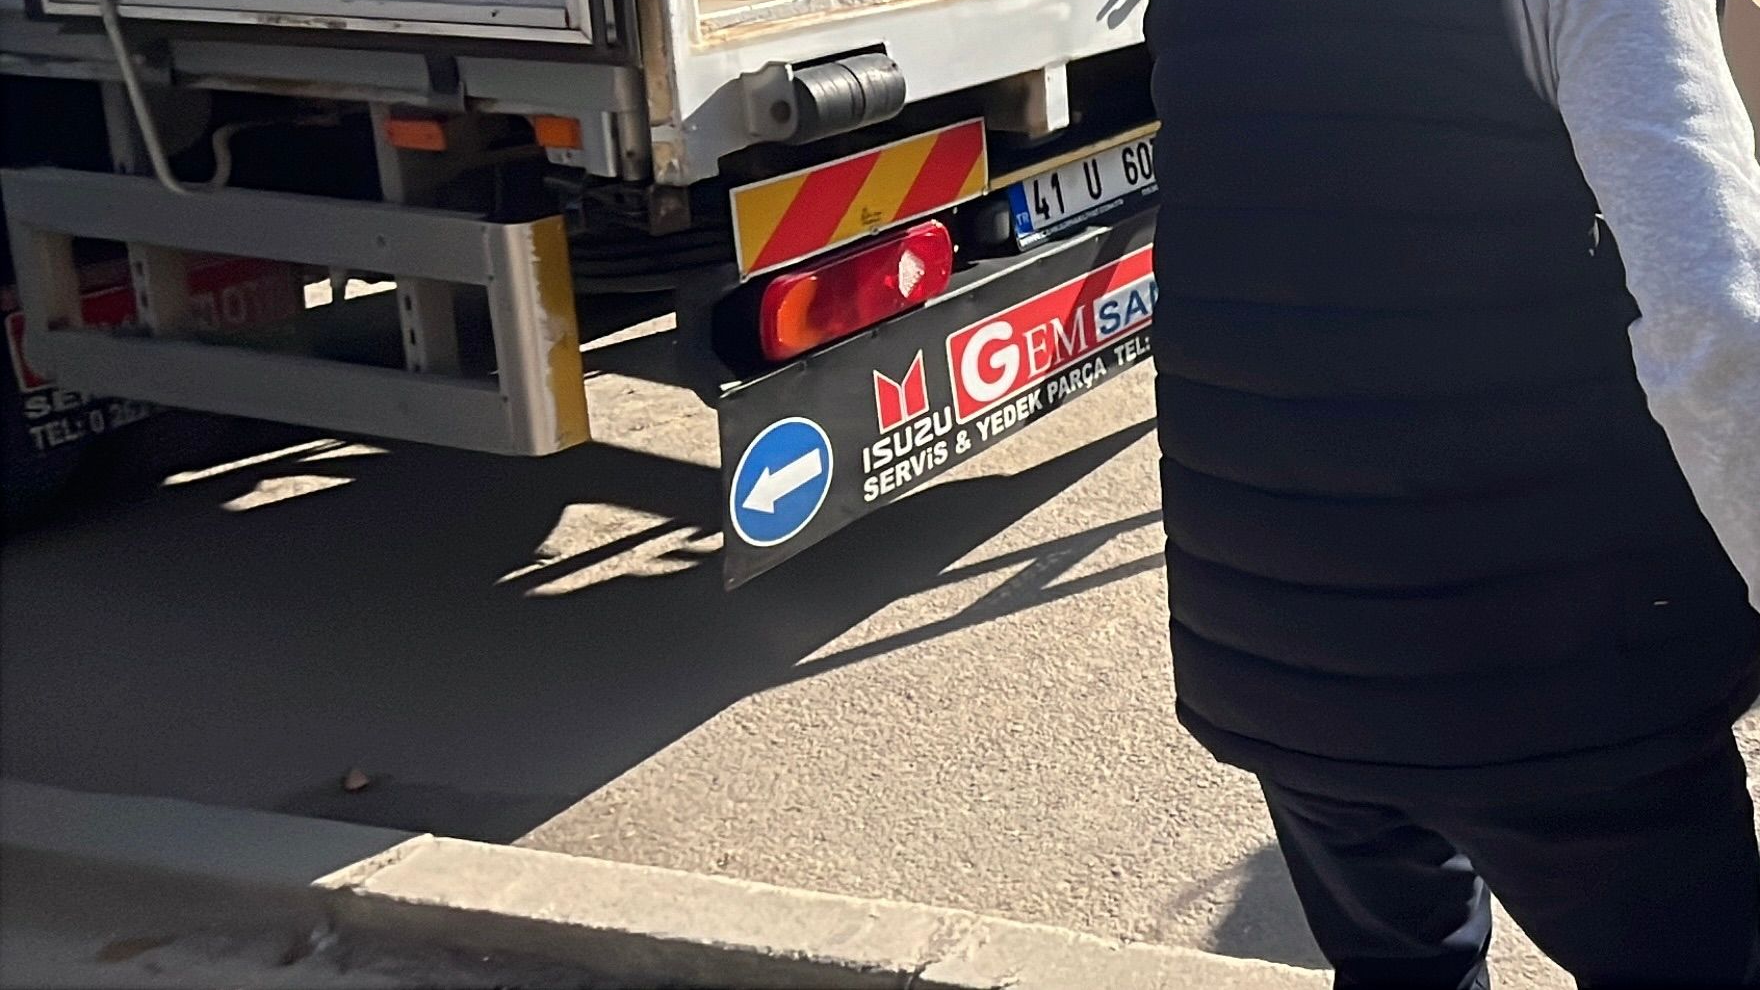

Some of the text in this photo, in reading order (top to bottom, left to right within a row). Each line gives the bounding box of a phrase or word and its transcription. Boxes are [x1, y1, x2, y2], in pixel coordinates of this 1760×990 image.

[1033, 138, 1155, 220] 41 U 60
[1016, 211, 1030, 226] TR
[955, 430, 972, 454] &
[975, 392, 1043, 442] YEDEK
[1048, 357, 1107, 404] PARÇA
[1113, 335, 1151, 366] TEL:
[862, 406, 952, 473] ISUZU
